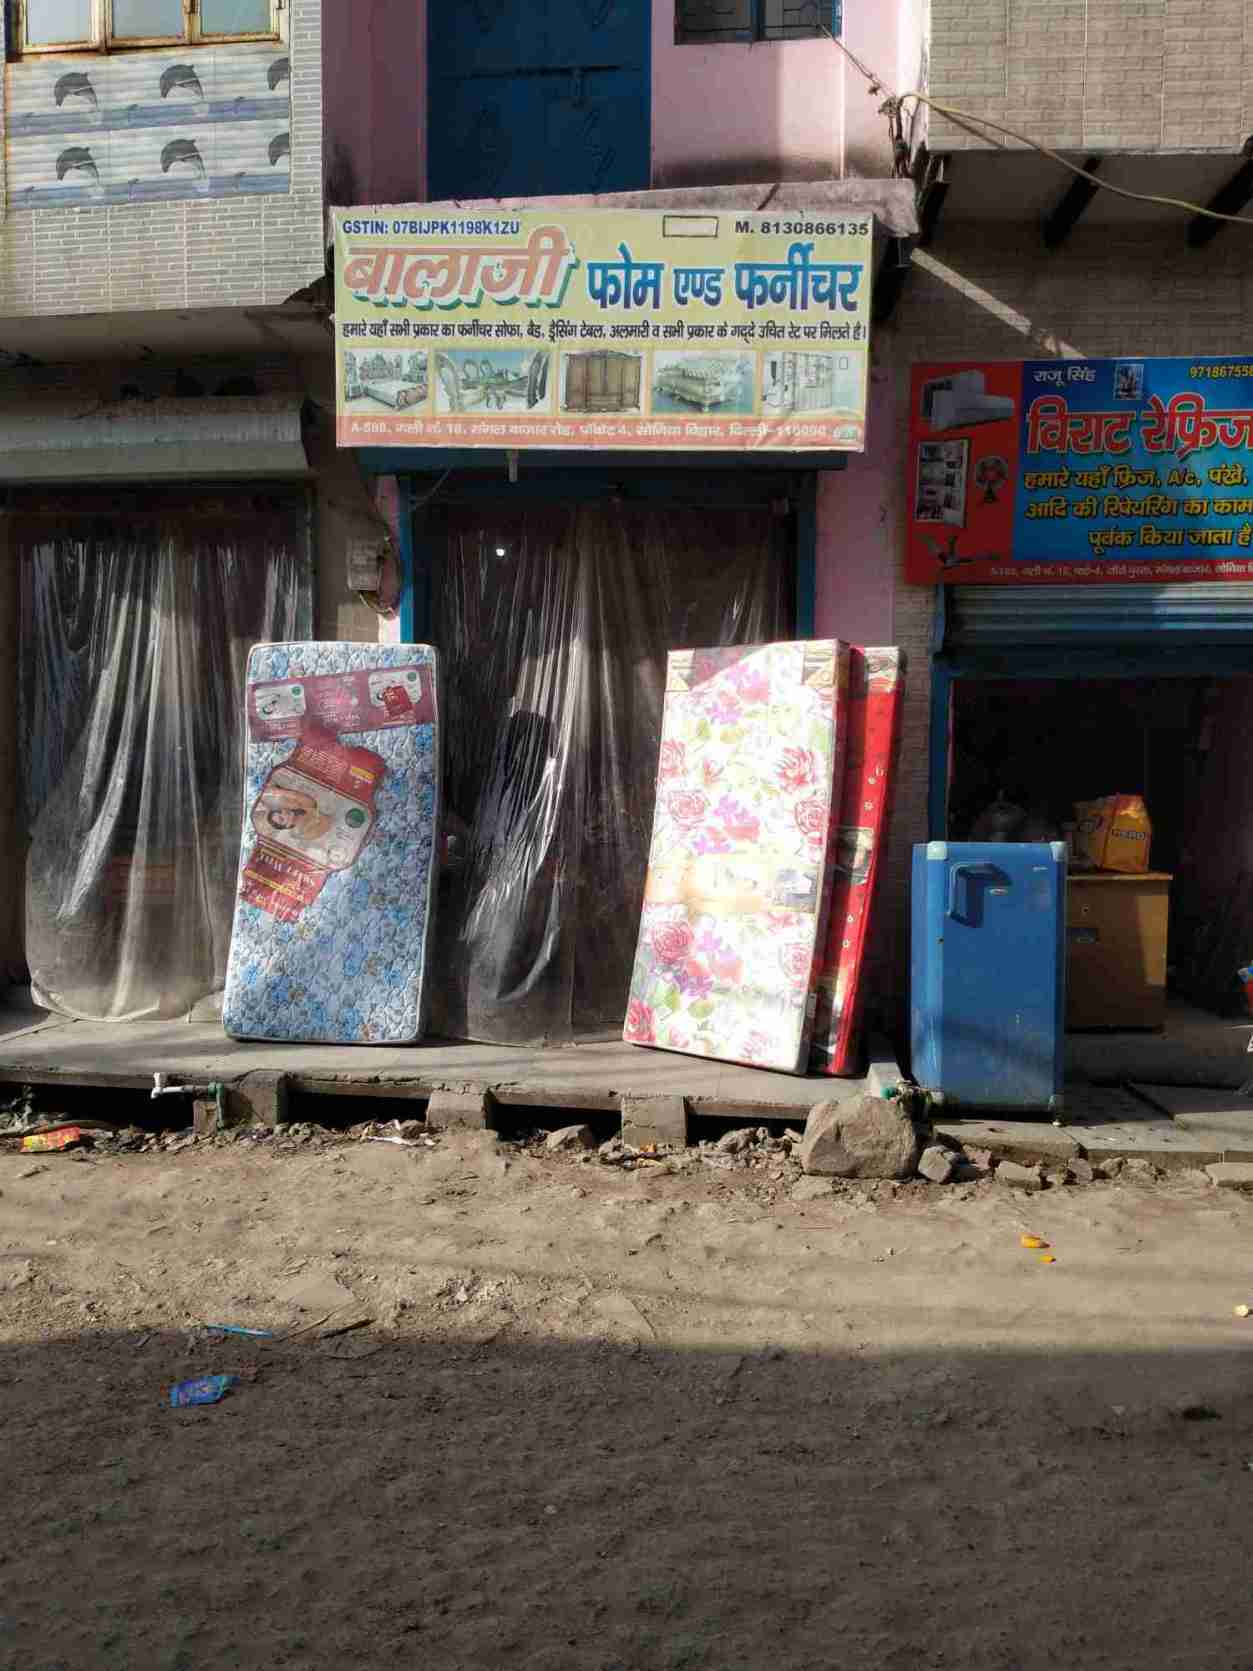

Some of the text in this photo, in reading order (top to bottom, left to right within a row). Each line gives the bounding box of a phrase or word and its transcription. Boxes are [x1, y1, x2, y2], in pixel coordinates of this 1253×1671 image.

[342, 219, 520, 235] GSTIN: 07BIJPK1198K1ZU
[734, 220, 869, 236] M. 8130866135
[343, 224, 864, 312] बालाजी फोम एण्ड फर्नीचर
[342, 319, 367, 339] हमारे
[389, 319, 410, 339] सभी
[412, 319, 441, 339] प्रकार
[441, 319, 455, 339] का
[609, 319, 650, 339] अलमारी
[652, 324, 660, 339] व
[663, 319, 684, 339] सभी
[686, 319, 715, 339] प्रकार
[716, 319, 728, 339] के
[758, 320, 785, 340] उचित
[787, 321, 801, 340] रेट
[803, 324, 817, 340] पर
[820, 320, 850, 341] मिलते
[1032, 367, 1064, 386] राजू
[1067, 366, 1097, 383] सिंह
[1026, 394, 1137, 455] विराट
[1024, 465, 1071, 489] हमारे
[1025, 496, 1067, 518] आदि
[1072, 495, 1098, 517] की
[1184, 498, 1209, 516] का
[1140, 523, 1185, 546] किया
[1188, 527, 1233, 546] जाता
